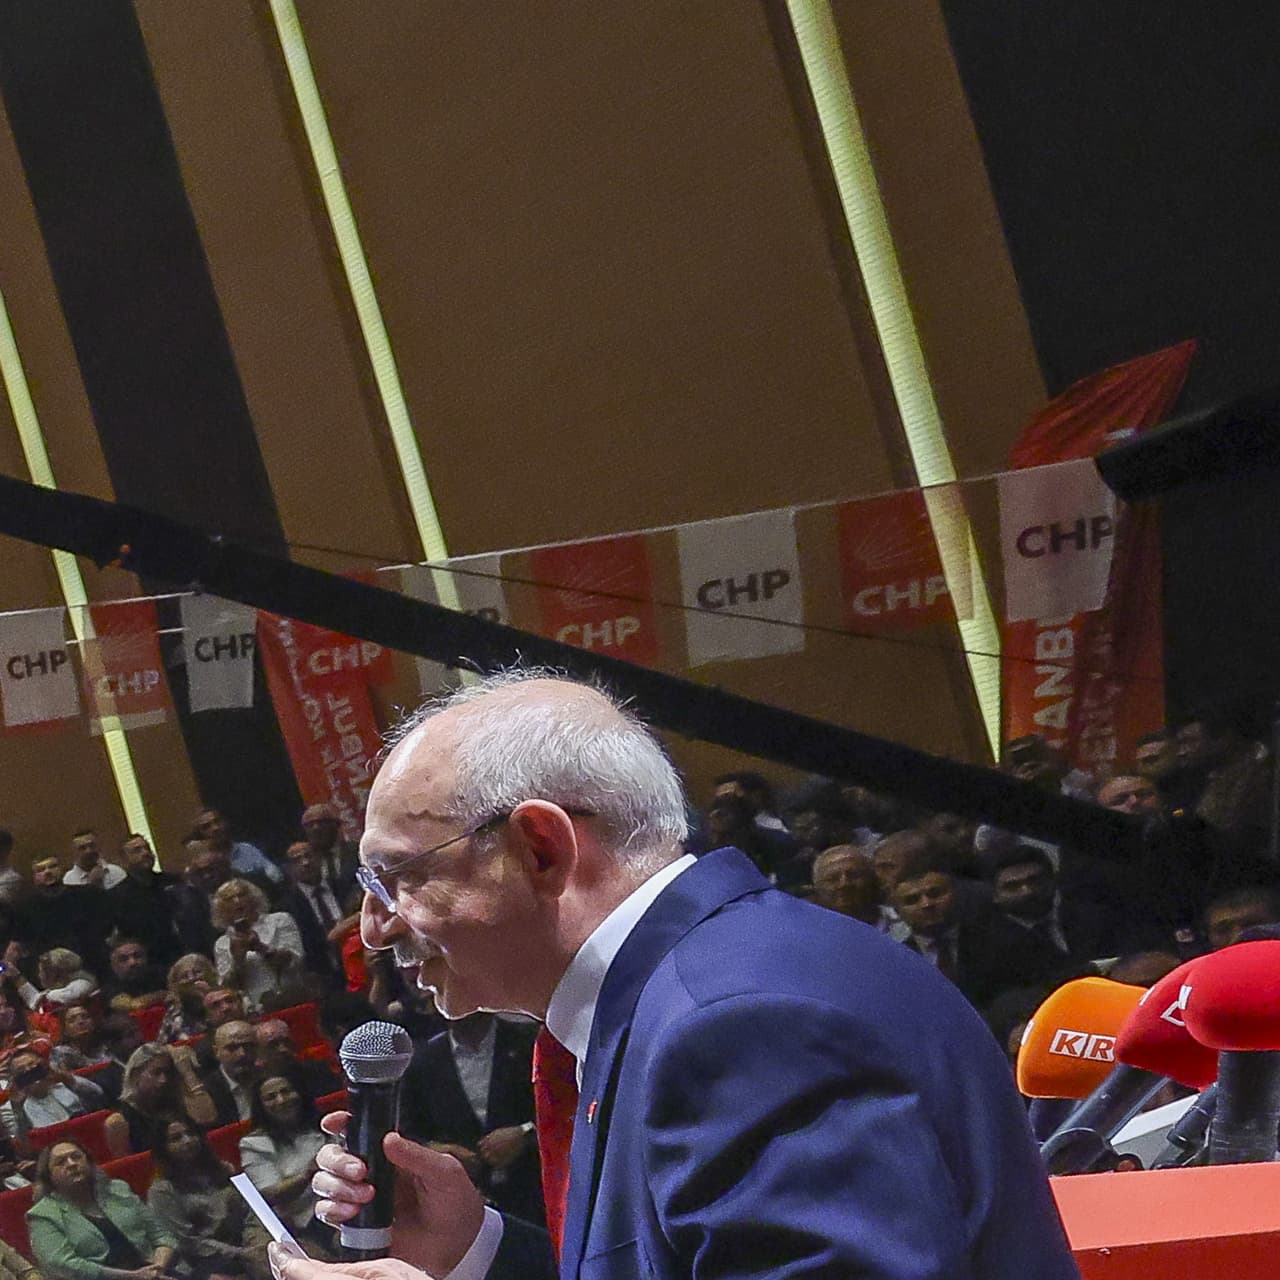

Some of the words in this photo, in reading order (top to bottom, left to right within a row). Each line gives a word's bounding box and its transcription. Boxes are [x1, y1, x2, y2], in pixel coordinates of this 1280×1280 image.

[1016, 516, 1115, 560] CHP
[697, 569, 791, 610] CHP
[852, 576, 952, 617] CHP
[194, 633, 256, 662] CHP
[556, 616, 640, 649] CHP
[7, 650, 68, 680] CHP
[309, 642, 383, 675] CHP
